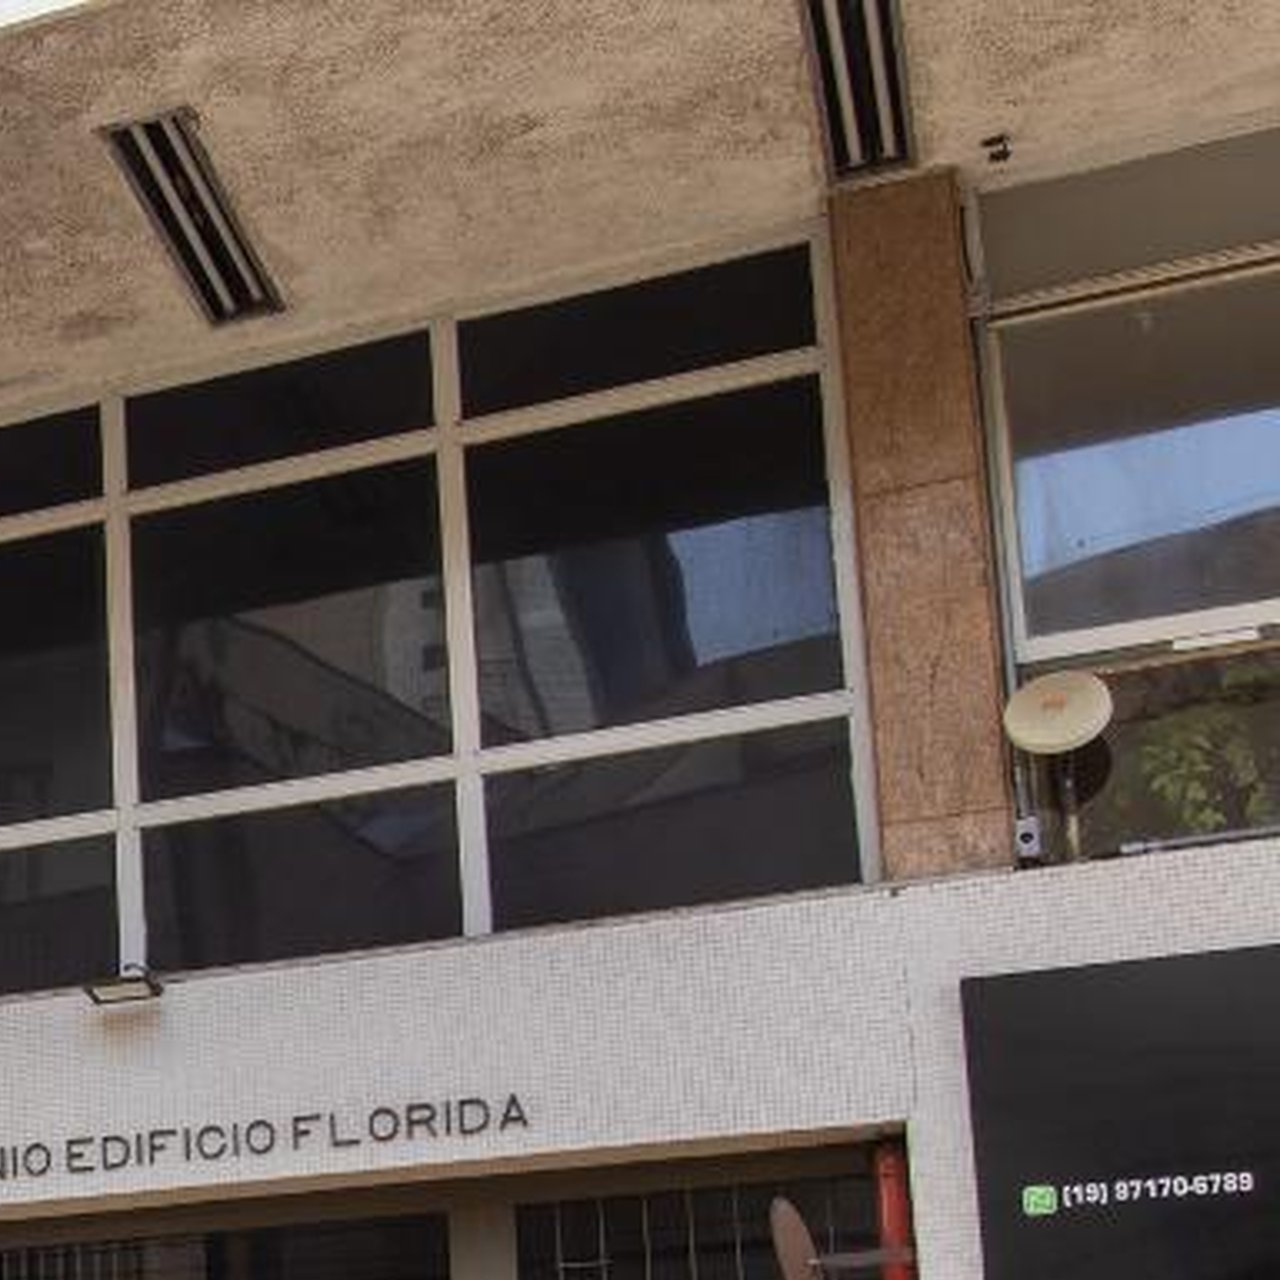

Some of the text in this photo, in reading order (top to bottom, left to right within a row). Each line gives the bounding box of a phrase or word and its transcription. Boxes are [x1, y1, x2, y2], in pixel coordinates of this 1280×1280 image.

[66, 1119, 276, 1174] EDIFICIO
[292, 1093, 529, 1150] FLORIDA
[1062, 1182, 1108, 1208] (19)
